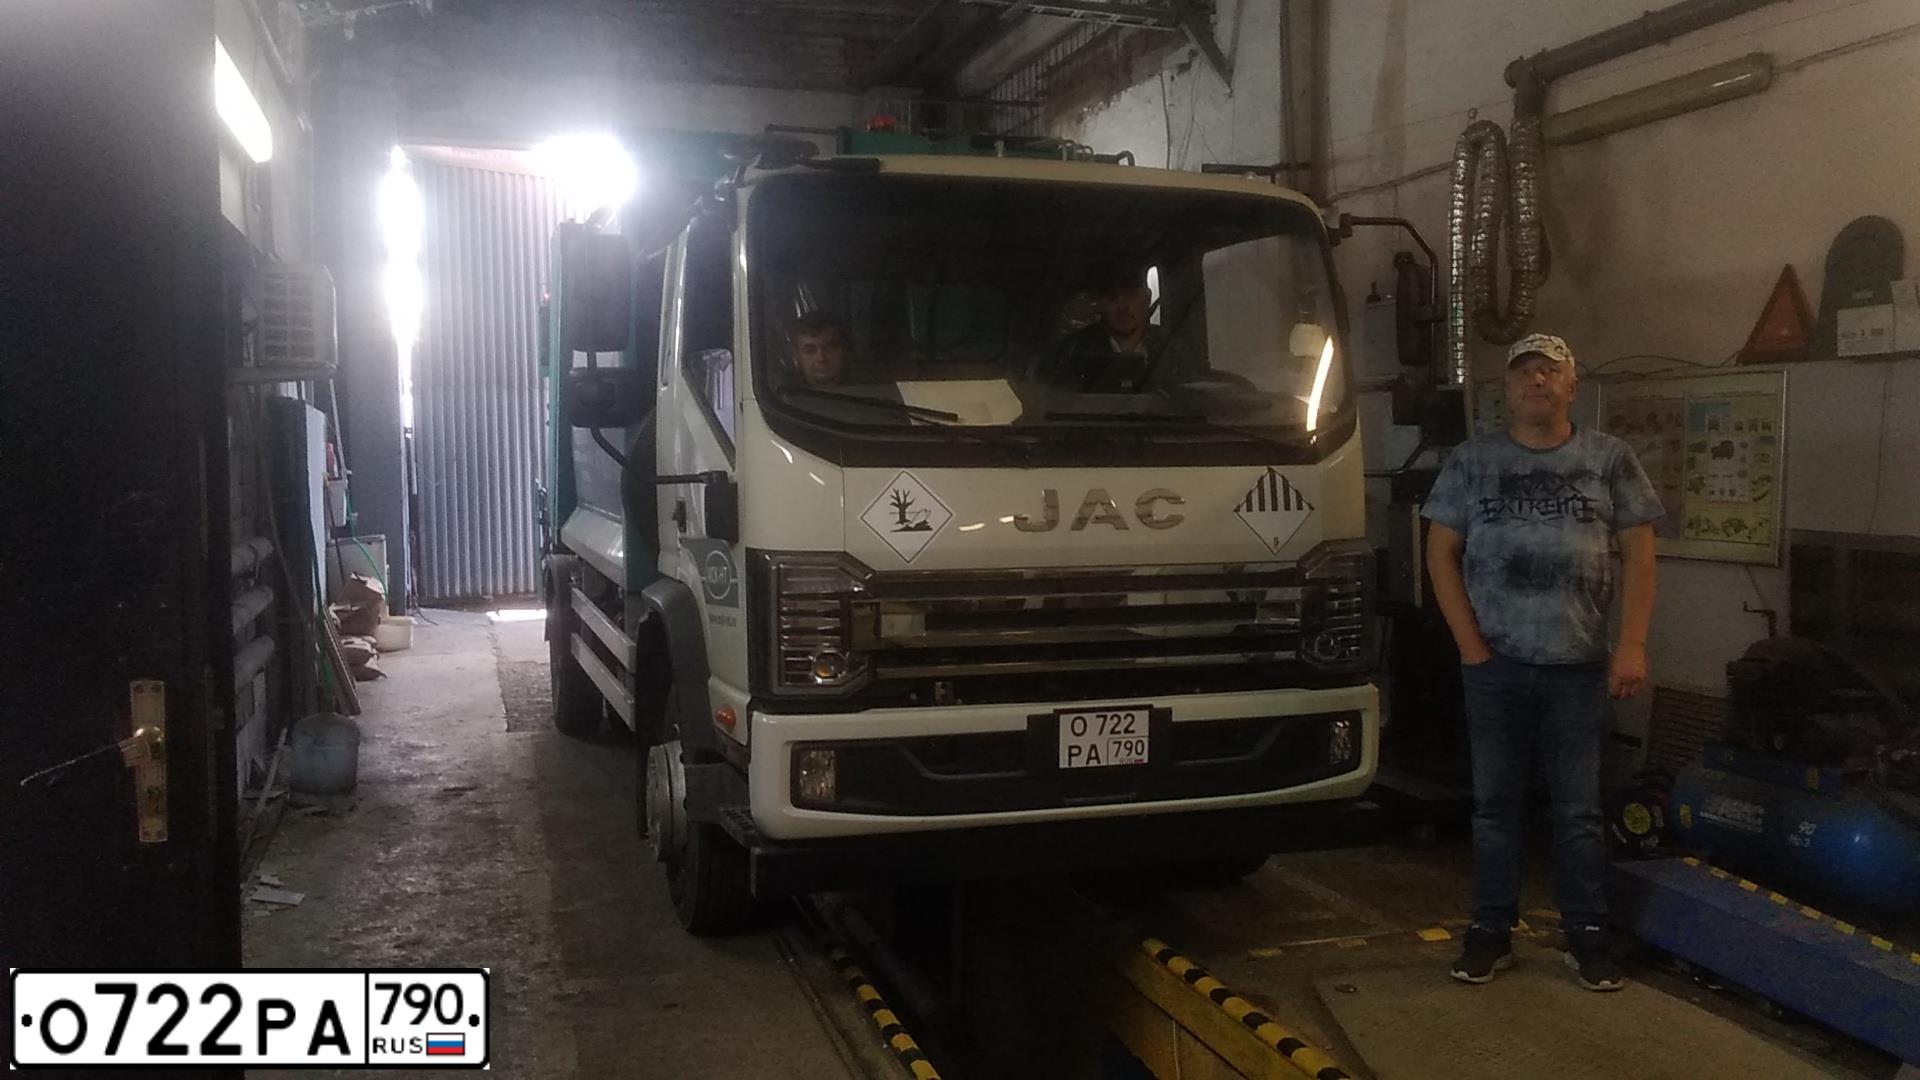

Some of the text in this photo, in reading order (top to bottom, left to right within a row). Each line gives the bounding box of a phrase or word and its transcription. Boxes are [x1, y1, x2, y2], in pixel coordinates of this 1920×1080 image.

[1014, 488, 1186, 532] JAC
[1272, 536, 1279, 548] 9
[1071, 713, 1135, 736] O 722
[1068, 744, 1101, 767] PA
[1113, 740, 1144, 757] 790
